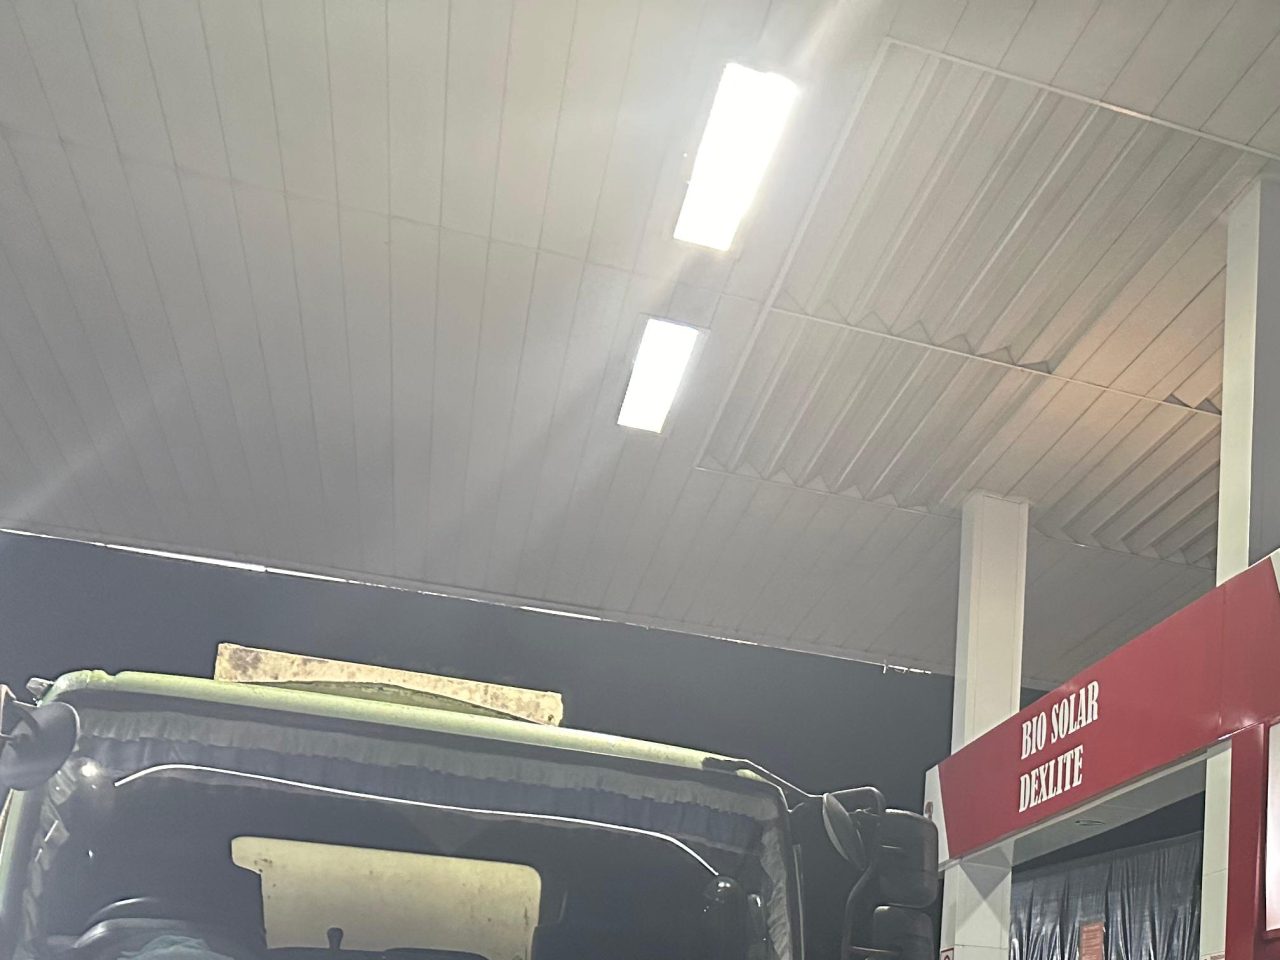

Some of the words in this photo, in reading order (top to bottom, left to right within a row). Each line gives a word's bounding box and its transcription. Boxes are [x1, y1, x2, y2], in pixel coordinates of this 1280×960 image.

[1021, 711, 1047, 760] BIO
[1051, 681, 1099, 744] SOLAR
[1019, 744, 1084, 813] DEXLITE
